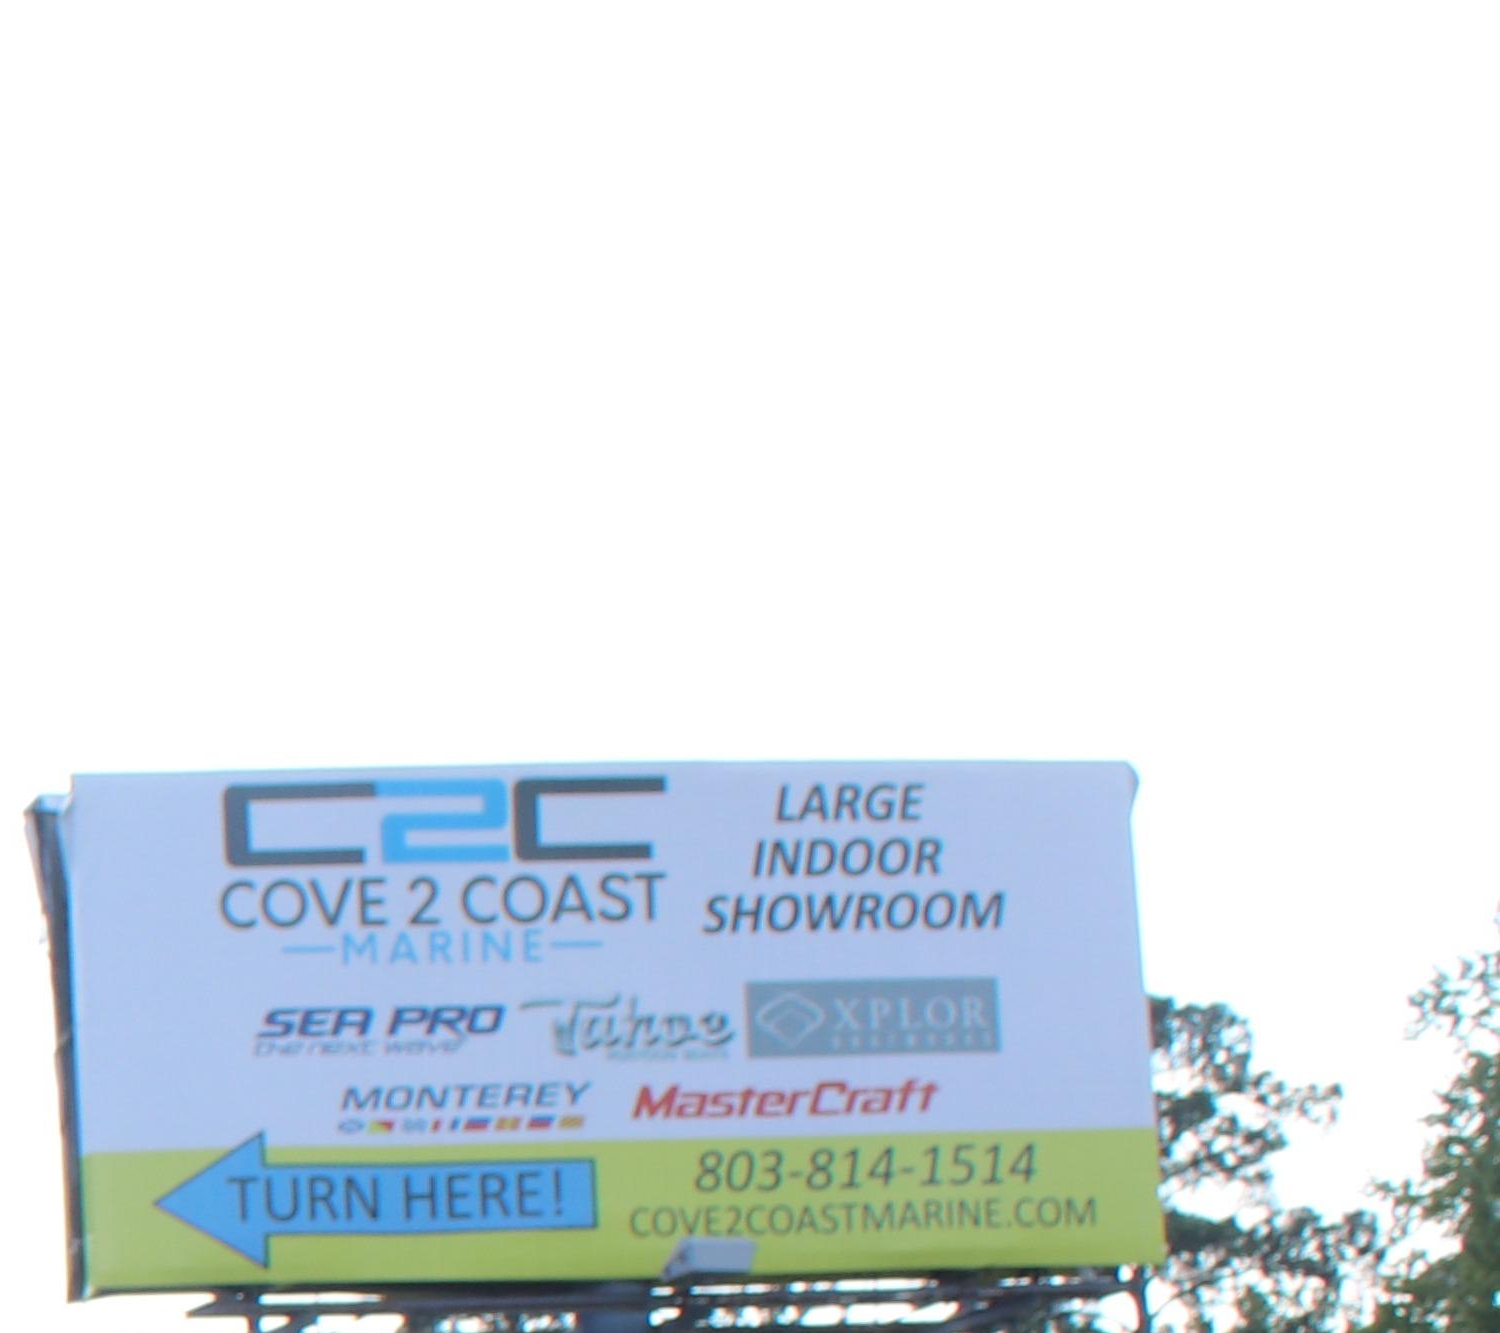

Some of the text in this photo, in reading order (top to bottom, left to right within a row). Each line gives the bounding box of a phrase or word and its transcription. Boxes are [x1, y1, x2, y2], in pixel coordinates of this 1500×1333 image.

[224, 776, 666, 866] C2C
[775, 782, 924, 823] LARGE
[752, 837, 942, 878] INDOOR
[219, 871, 665, 928] COVE 2 COAST
[702, 891, 1006, 935] SHOWROOM
[341, 929, 543, 965] MARINE
[256, 1004, 506, 1038] SEA PRO
[519, 993, 736, 1056] Tahoe
[833, 996, 989, 1031] XPLOR
[341, 1081, 591, 1113] MONTEREY
[631, 1079, 940, 1120] MasterCraft
[694, 1141, 1037, 1194] 803-814-1514
[225, 1169, 565, 1223] TURN HERE!
[629, 1196, 1097, 1239] COVE2COASTMARINE.COM
